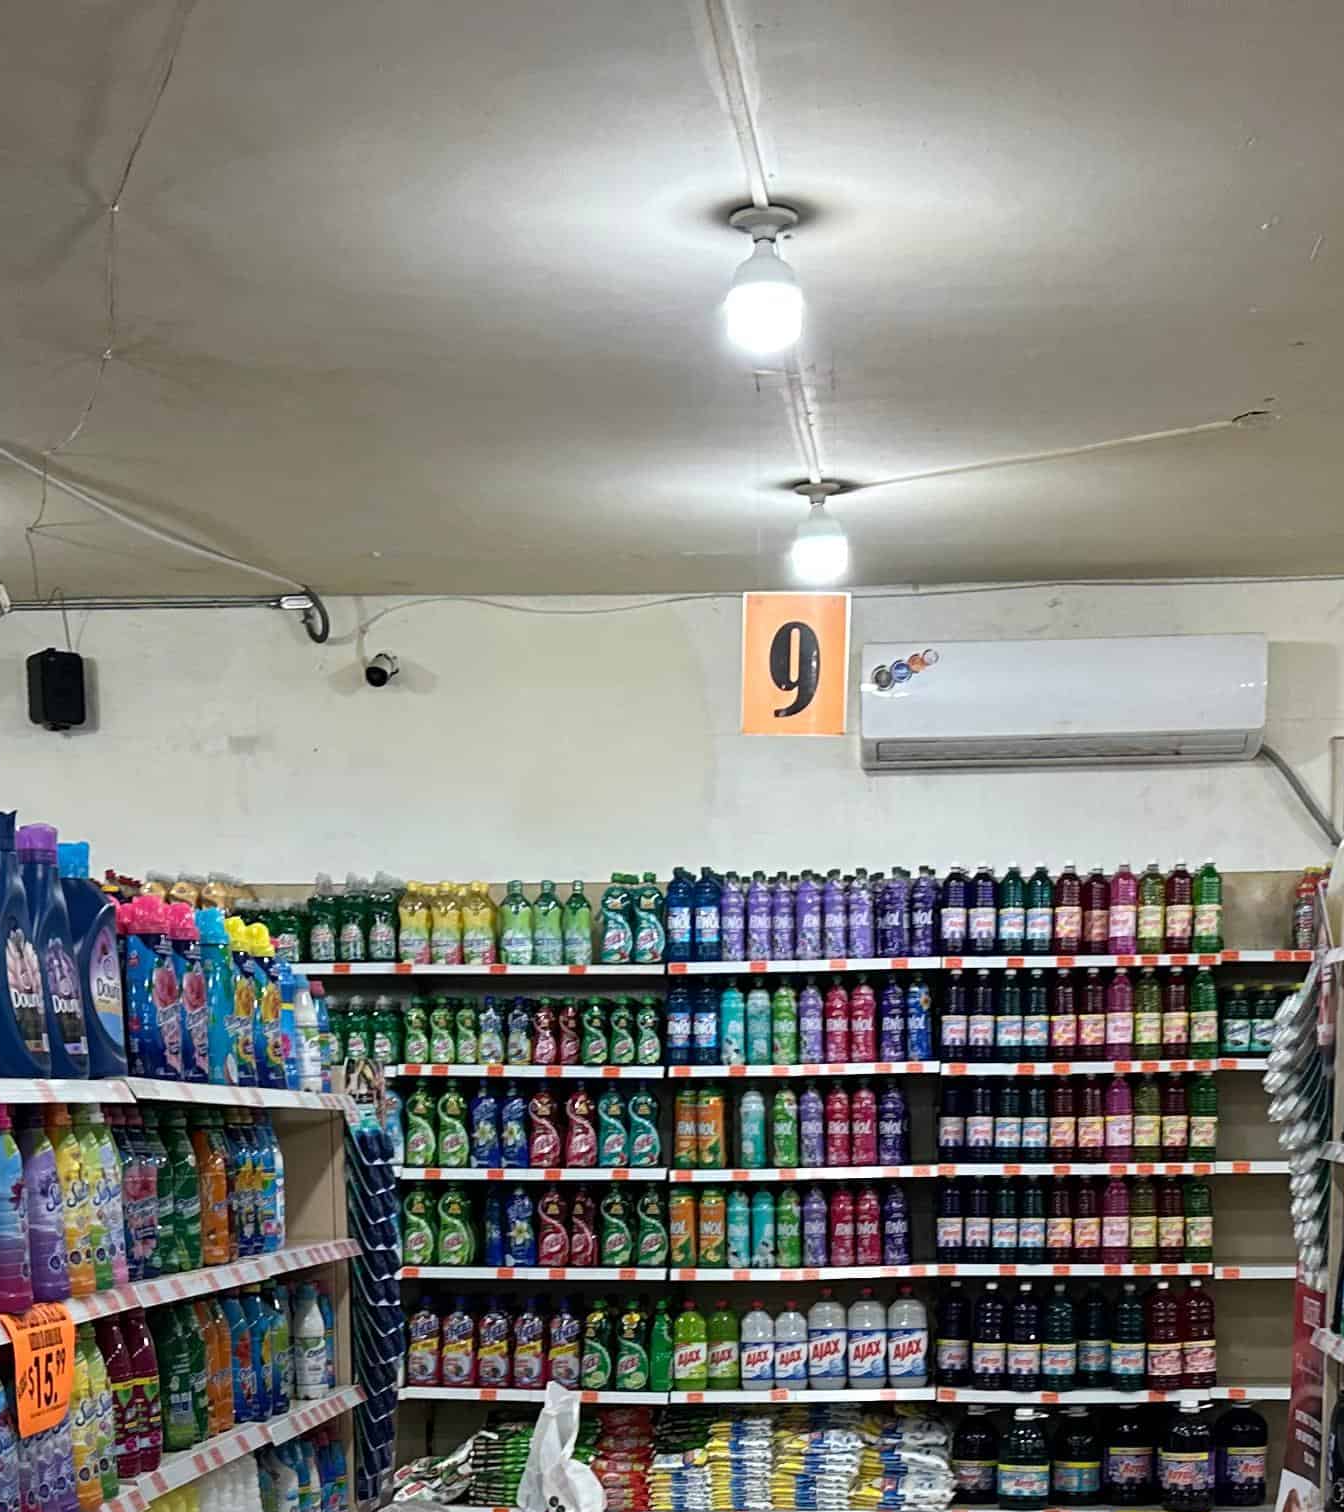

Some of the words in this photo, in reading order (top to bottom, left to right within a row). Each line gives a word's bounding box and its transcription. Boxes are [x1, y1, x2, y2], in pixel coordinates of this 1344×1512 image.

[769, 620, 821, 719] 9
[811, 1339, 840, 1360] AJAX
[852, 1342, 882, 1361] AJAX
[892, 1339, 922, 1360] AJAX
